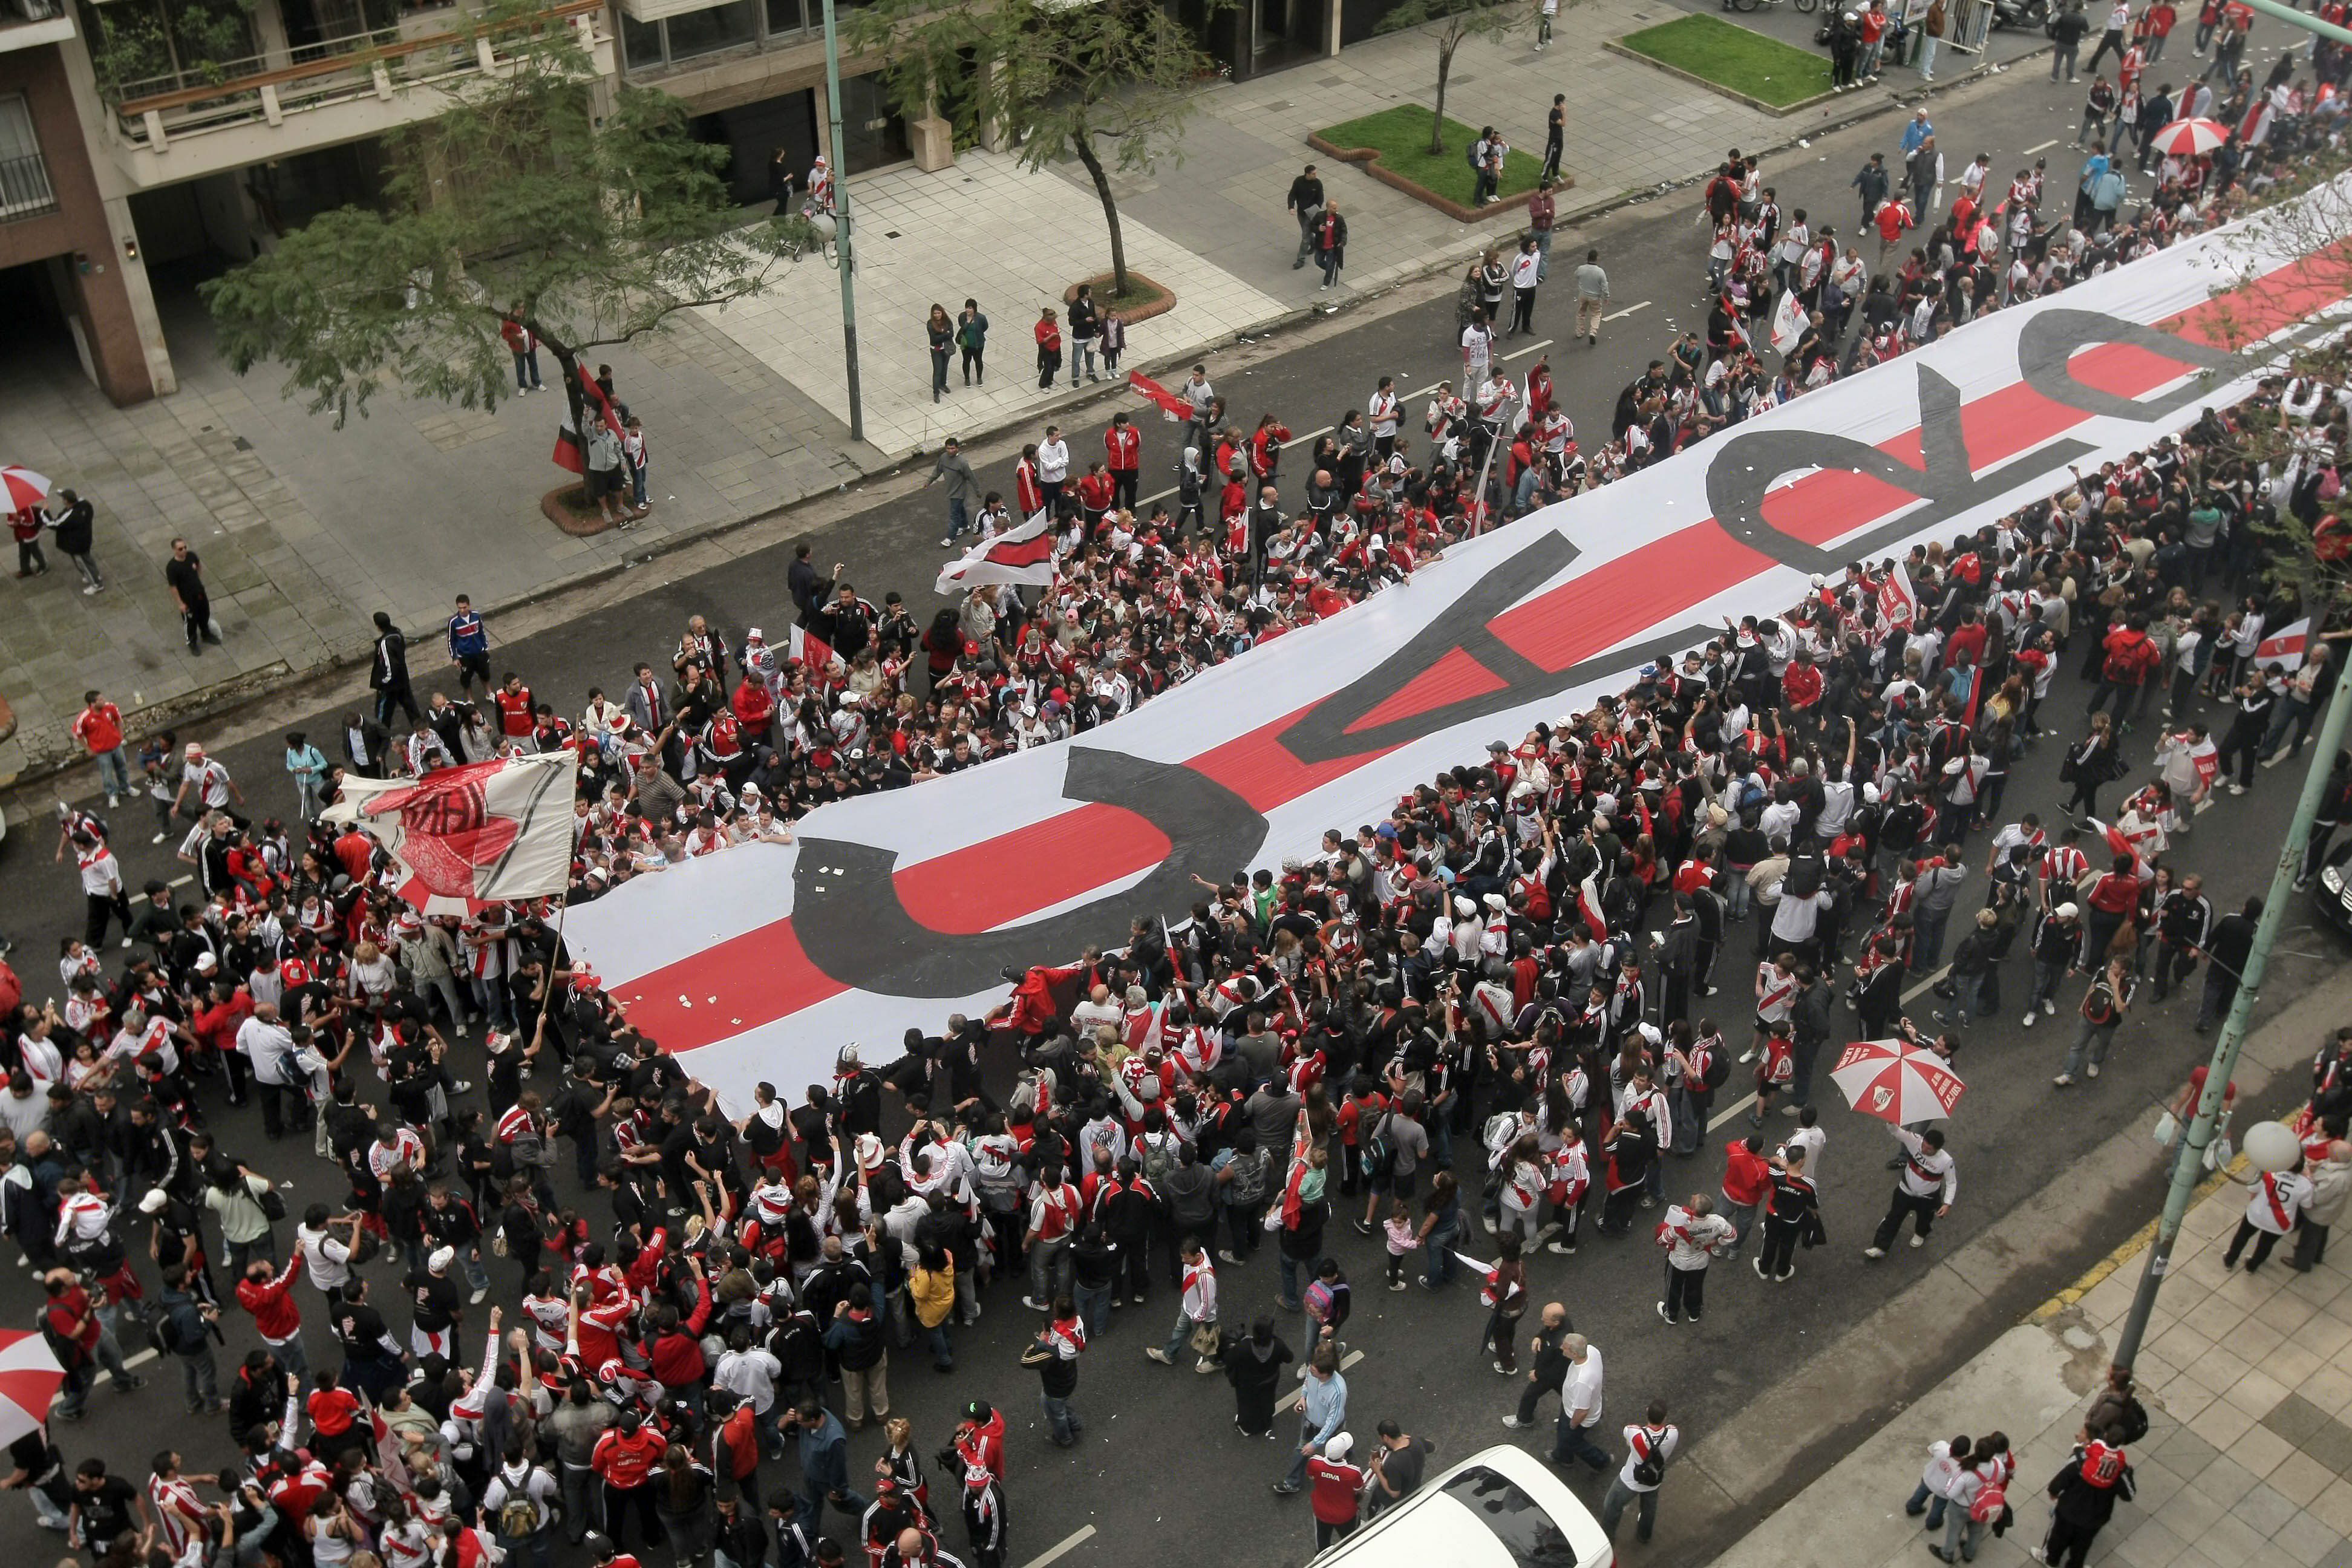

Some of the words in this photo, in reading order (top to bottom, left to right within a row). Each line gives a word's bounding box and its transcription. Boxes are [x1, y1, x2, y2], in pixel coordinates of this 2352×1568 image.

[1886, 584, 1897, 603] MAS
[1164, 1035, 1178, 1044] BBVA
[1944, 1083, 1962, 1109] LEJOS
[1778, 1186, 1801, 1196] LUBRAX
[785, 1327, 800, 1340] RIVER
[2096, 1455, 2118, 1479] 10
[1321, 1471, 1341, 1481] BBVA
